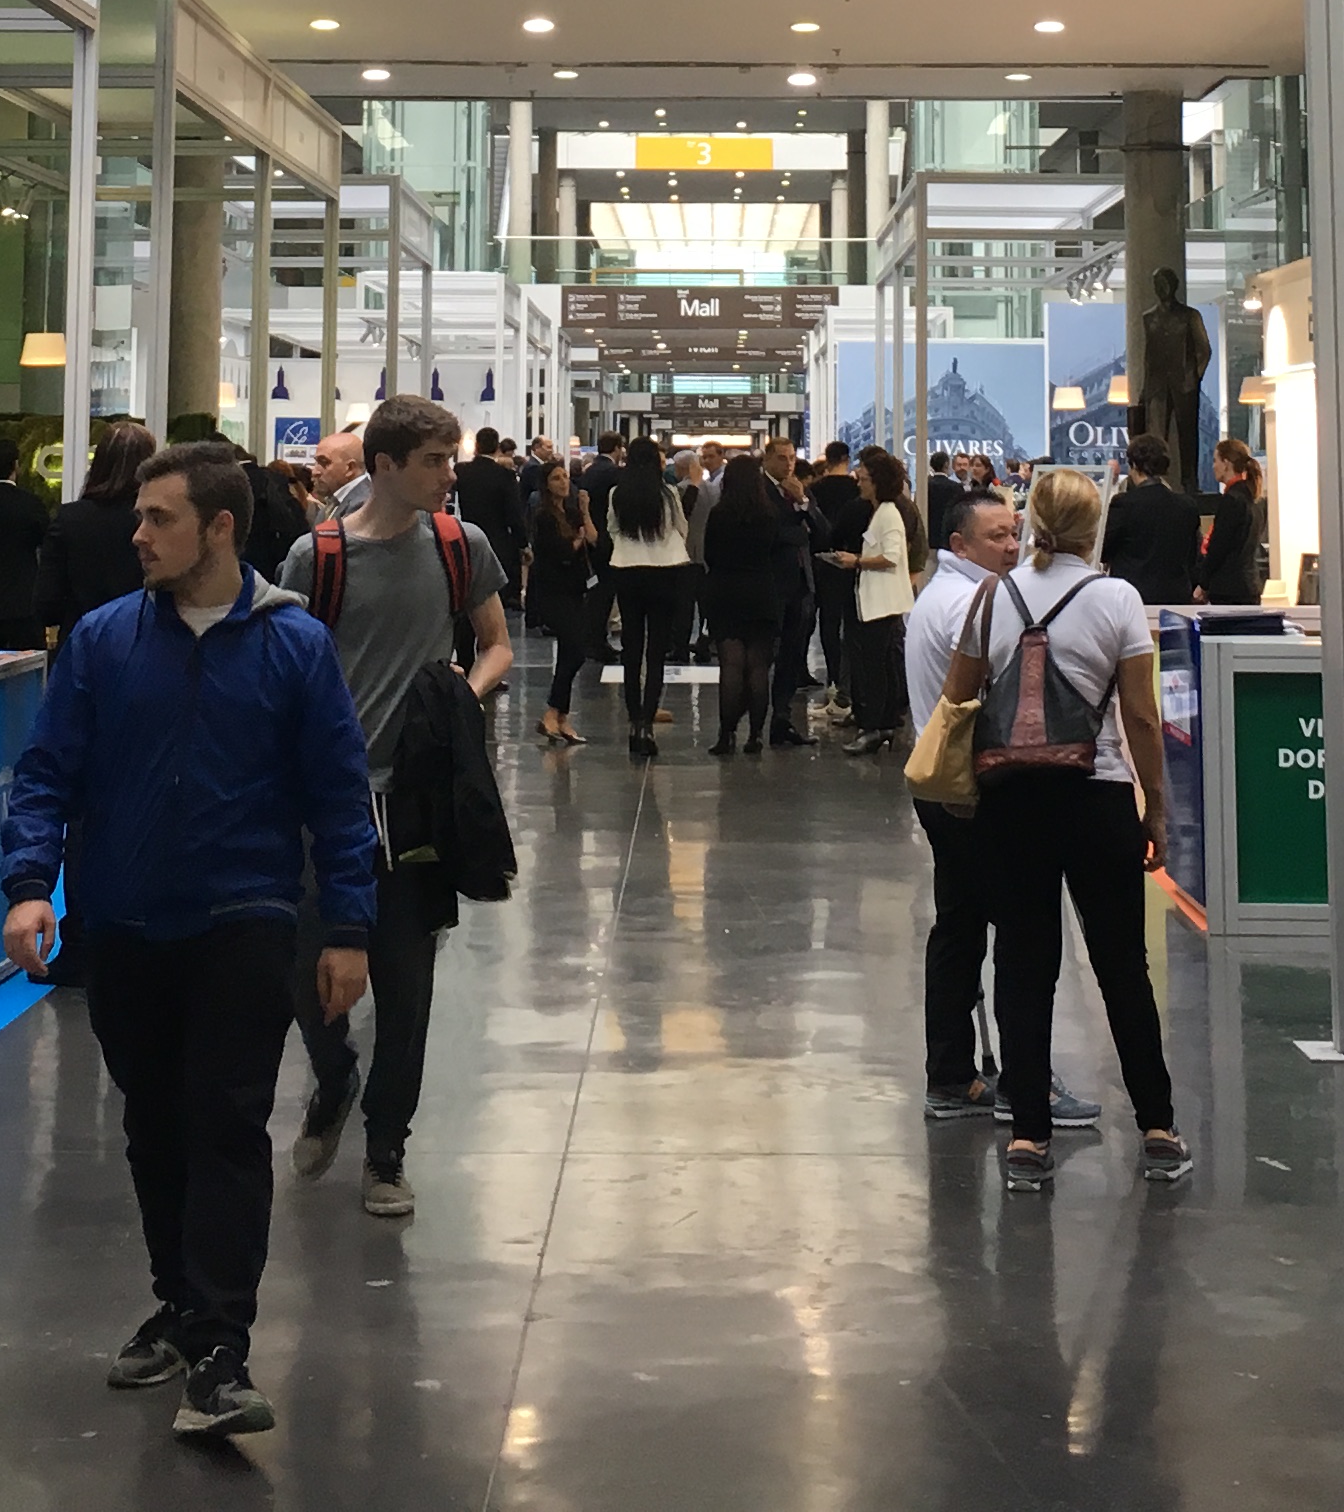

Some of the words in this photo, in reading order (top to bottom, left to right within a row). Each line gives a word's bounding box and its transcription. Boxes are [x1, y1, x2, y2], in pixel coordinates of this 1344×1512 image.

[697, 142, 712, 165] 3
[680, 298, 720, 317] Mall
[698, 398, 720, 409] Mall
